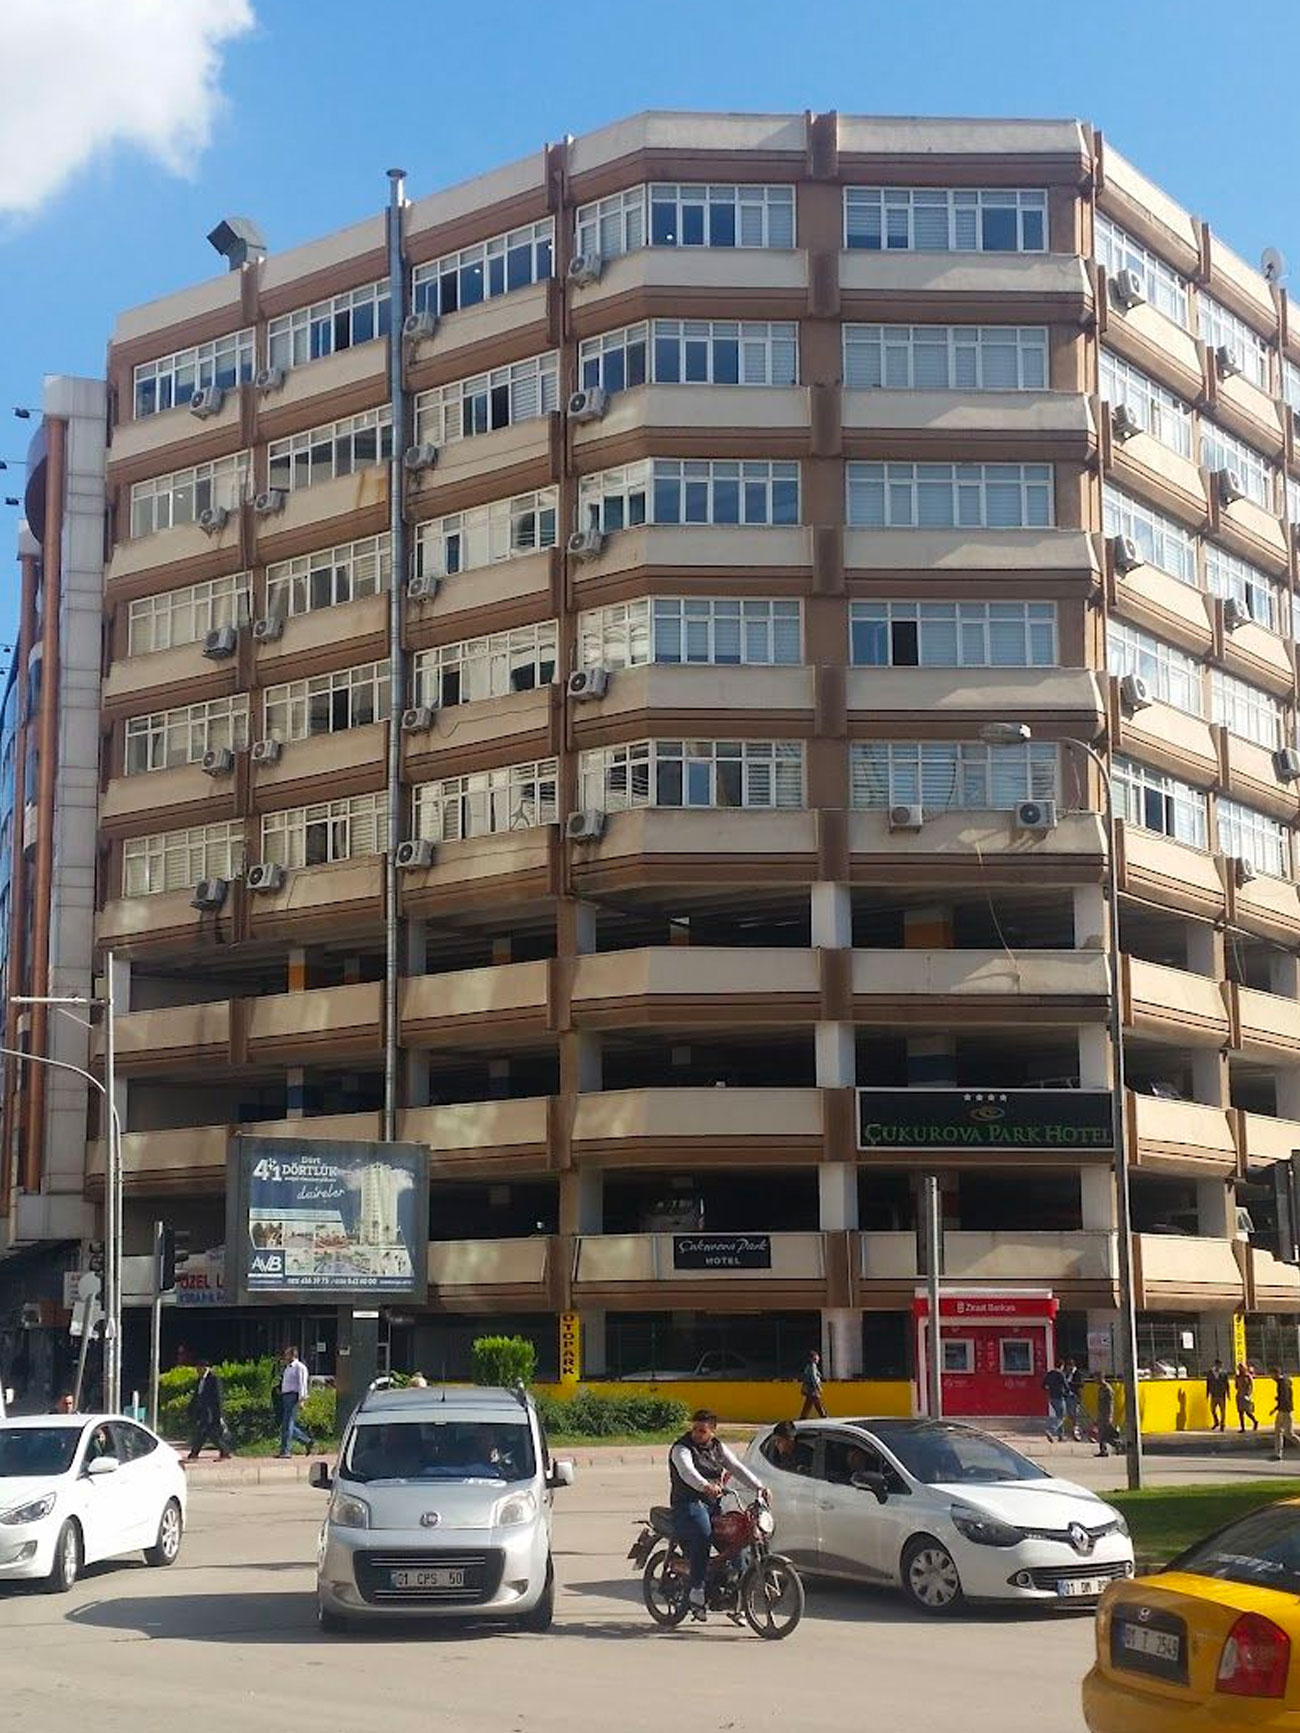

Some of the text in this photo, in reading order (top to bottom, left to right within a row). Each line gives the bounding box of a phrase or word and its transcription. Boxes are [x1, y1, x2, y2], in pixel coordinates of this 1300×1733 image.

[865, 1123, 1112, 1145] ÇUKUROVA PARK HOTEL
[735, 1238, 768, 1253] Park
[705, 1256, 741, 1265] HOTEL
[562, 1313, 575, 1376] OTOPARK
